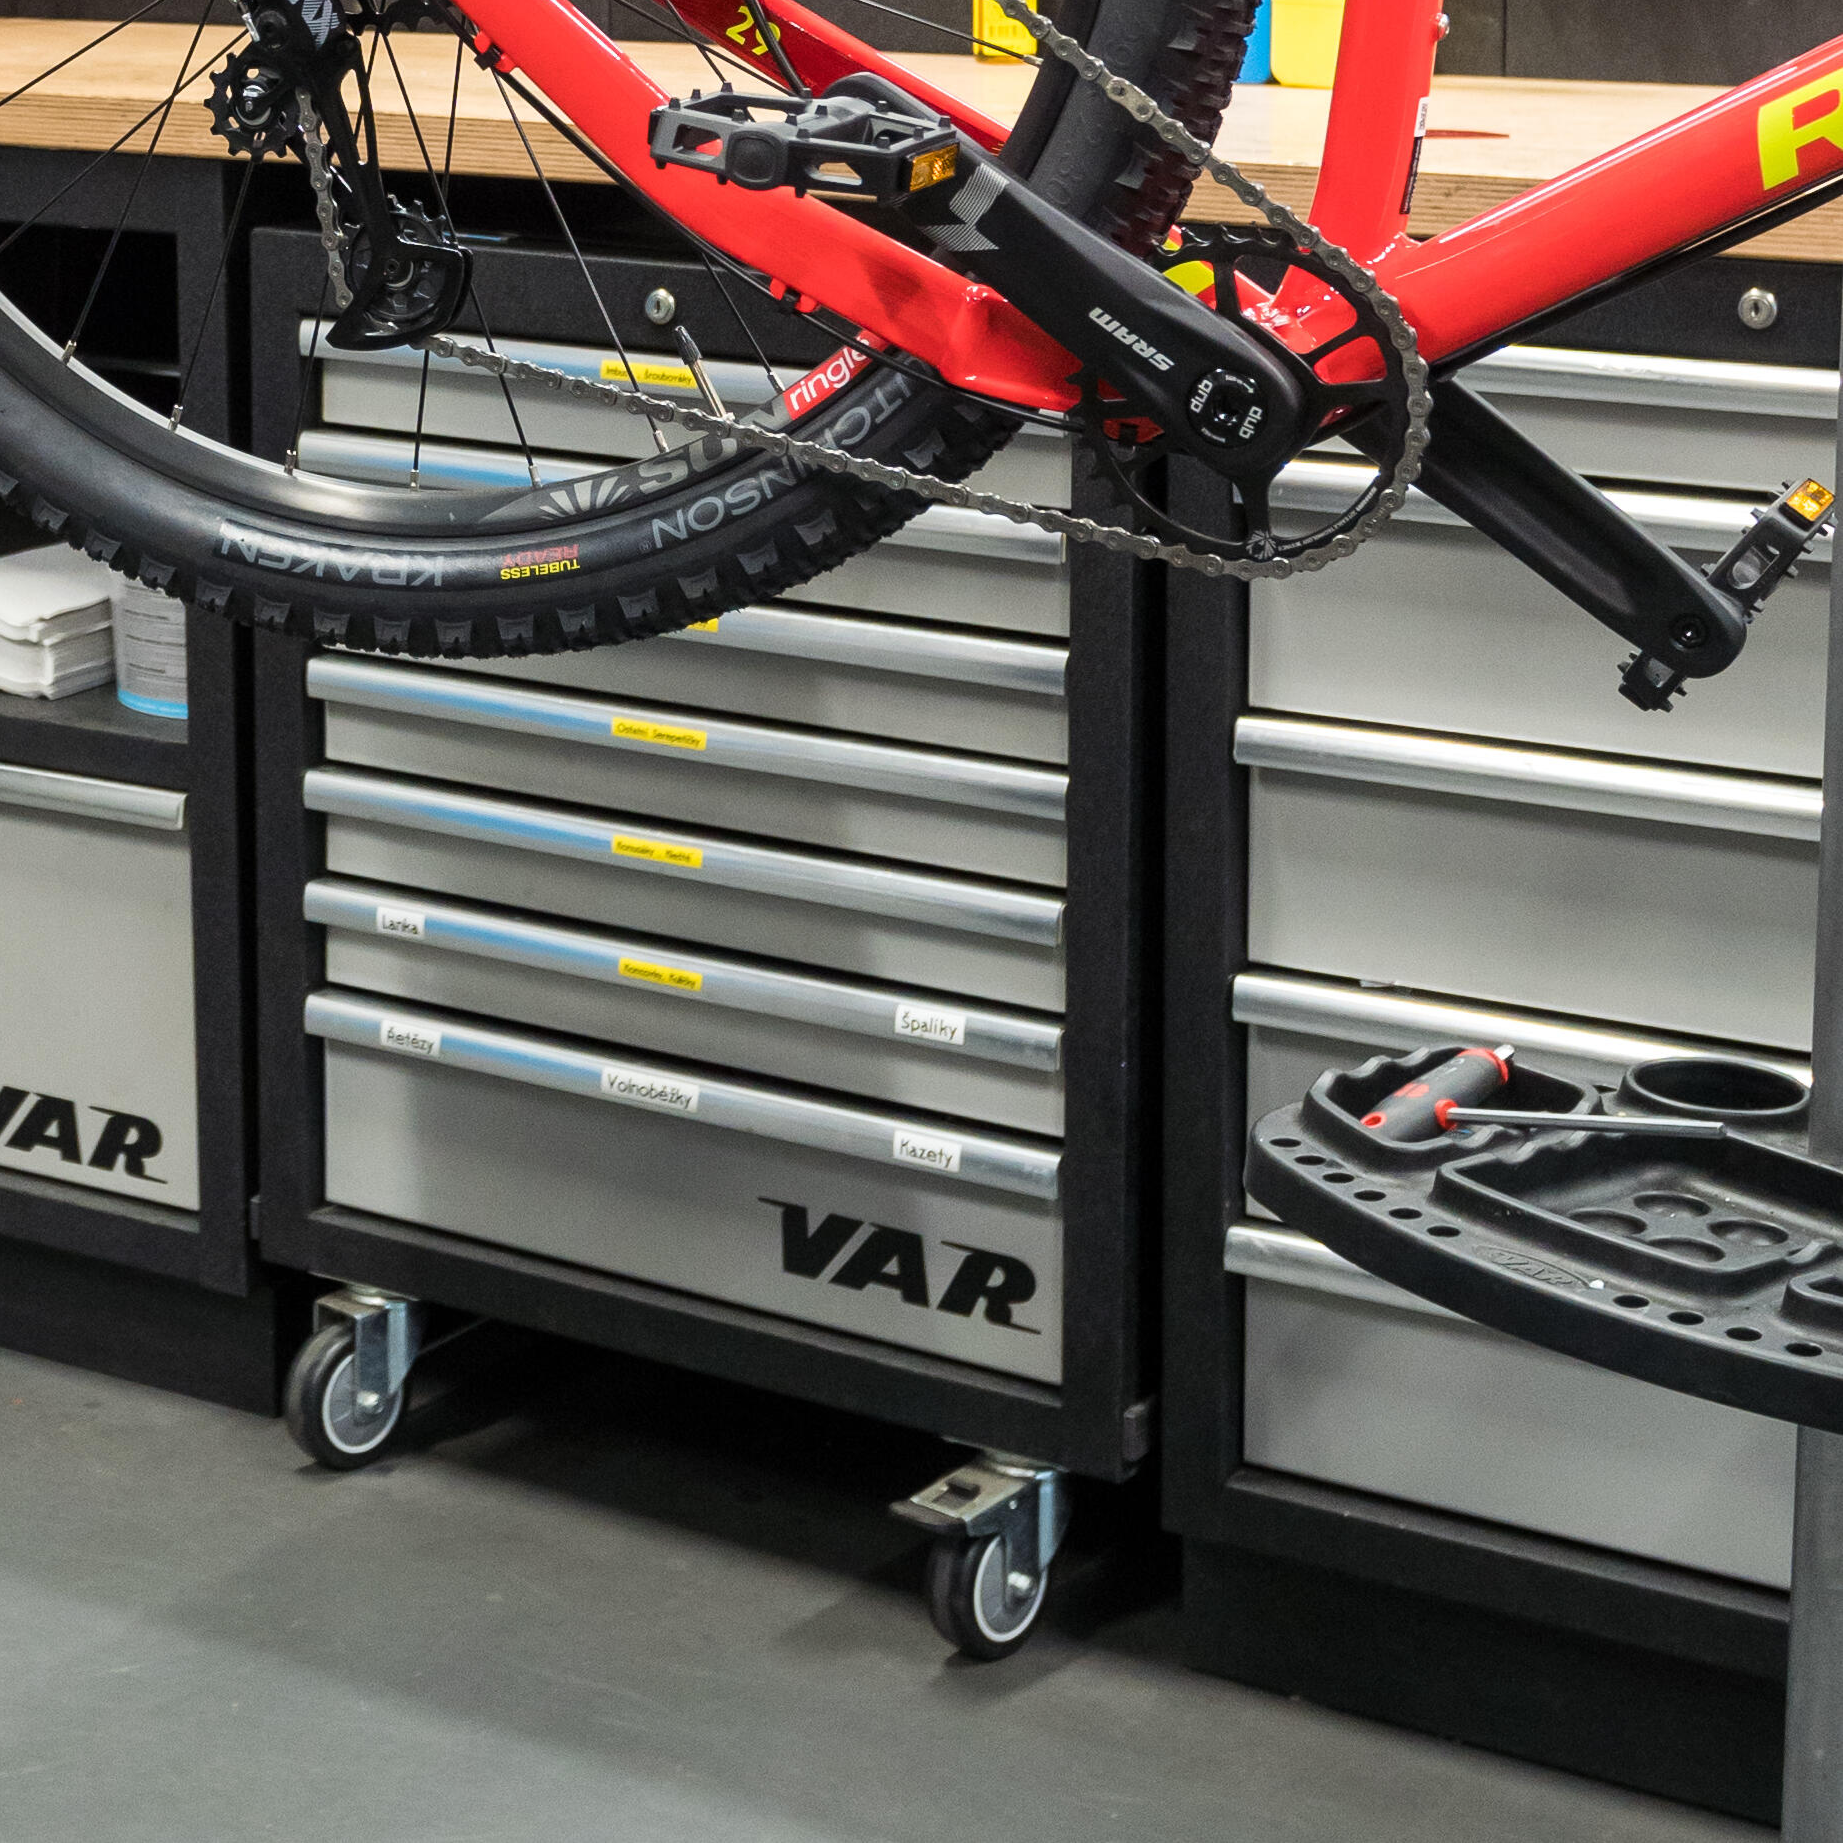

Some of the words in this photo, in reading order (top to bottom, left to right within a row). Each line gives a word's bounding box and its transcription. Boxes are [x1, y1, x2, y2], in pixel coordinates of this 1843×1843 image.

[1088, 306, 1176, 371] SRAM
[1190, 378, 1214, 414] dub
[1238, 405, 1263, 440] dub
[500, 558, 581, 581] TUBELESS
[501, 543, 580, 568] READY
[382, 914, 419, 936] Lanka
[607, 1073, 694, 1110] Volnoběžky
[899, 1137, 954, 1169] Kazety
[757, 1196, 1041, 1334] VAR
